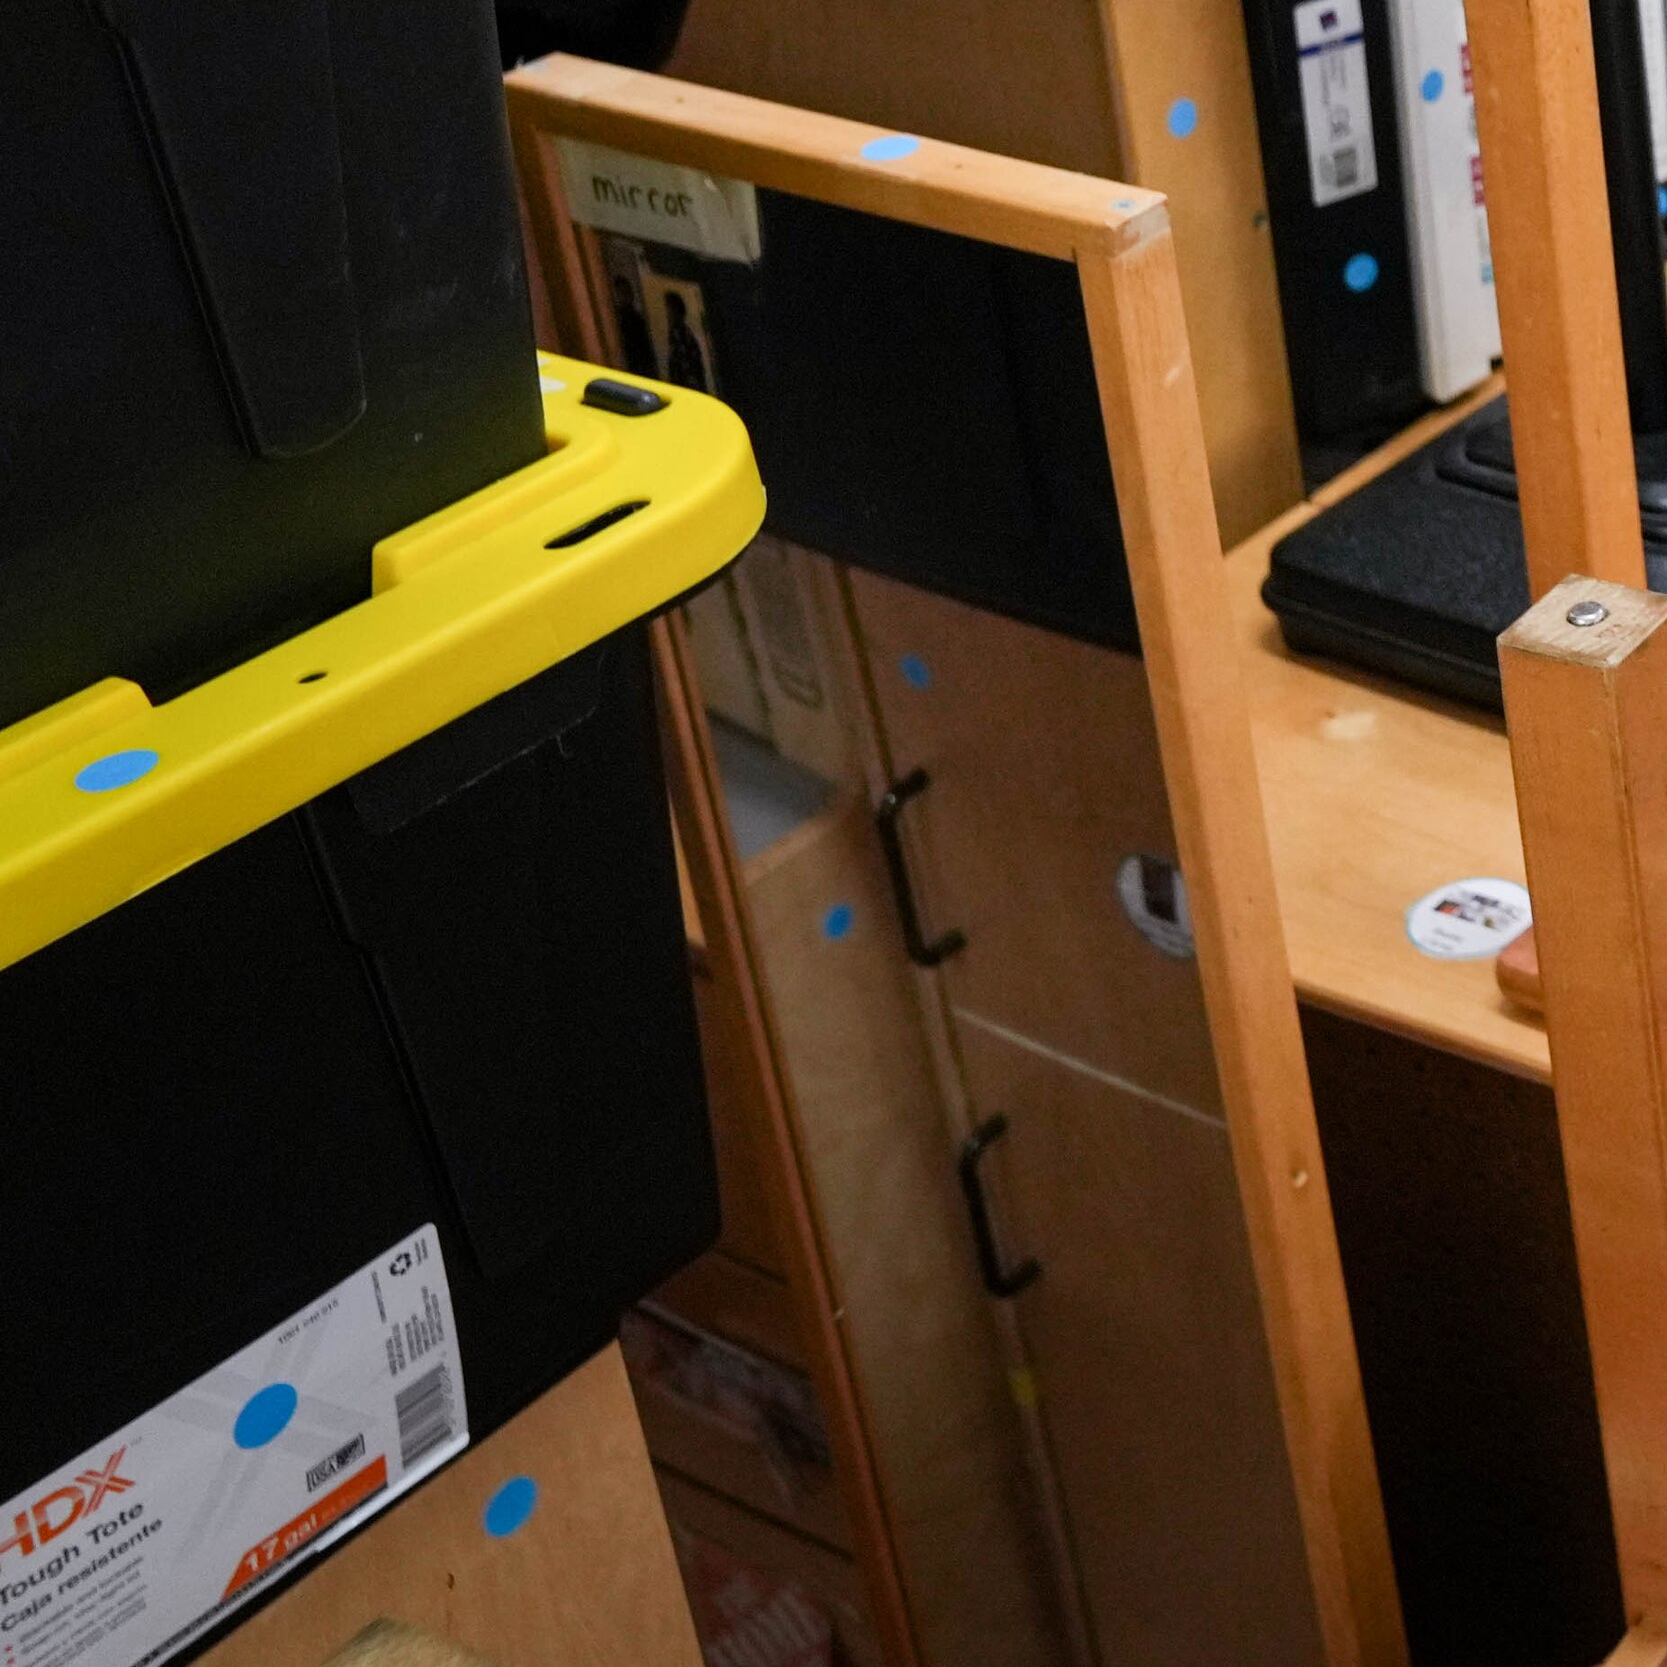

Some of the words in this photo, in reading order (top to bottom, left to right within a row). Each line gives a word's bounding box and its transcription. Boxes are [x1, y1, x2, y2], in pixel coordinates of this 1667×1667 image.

[591, 175, 694, 217] mirror
[0, 1545, 81, 1605] Tough
[87, 1502, 145, 1545] Tote
[1, 1592, 52, 1632] Caja
[58, 1518, 164, 1596] resistente
[246, 1536, 280, 1574] 17
[285, 1511, 319, 1551] gal
